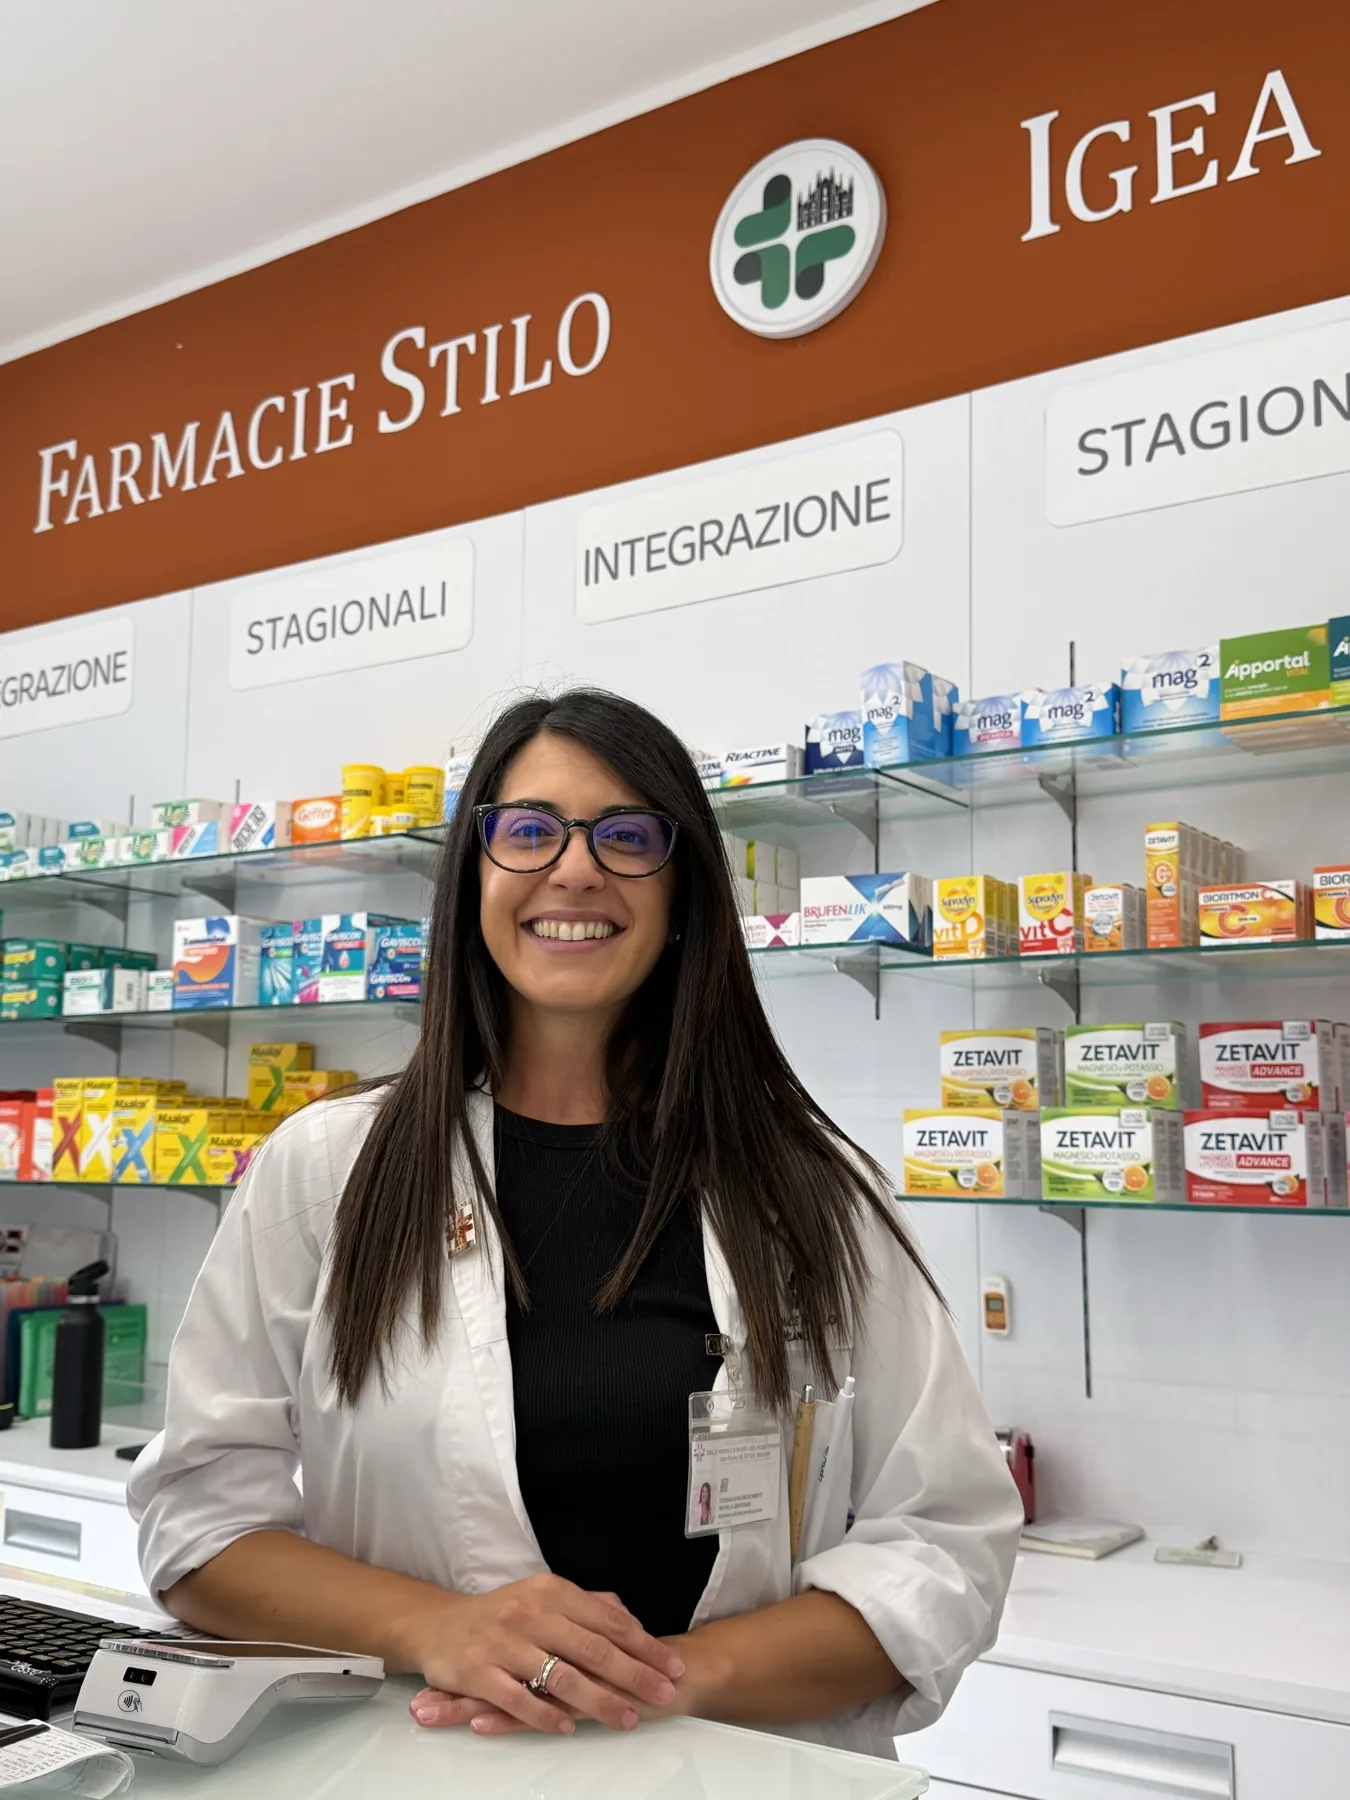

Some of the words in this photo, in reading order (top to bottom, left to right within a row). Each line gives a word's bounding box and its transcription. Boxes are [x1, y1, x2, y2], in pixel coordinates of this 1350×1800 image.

[1020, 69, 1322, 242] IGEA
[33, 375, 356, 534] FARMACIE
[377, 292, 611, 434] STILO
[1078, 372, 1350, 476] STAGION
[583, 478, 891, 586] INTEGRAZIONE
[246, 581, 447, 655] STAGIONALI
[1224, 650, 1310, 680] Apportal
[0, 650, 127, 708] GRAZIONE
[725, 747, 782, 763] REACTINE
[941, 895, 976, 908] Supradyn
[1027, 892, 1064, 905] Supradyn
[1202, 891, 1259, 903] BIORITMON
[1019, 921, 1047, 940] vit
[953, 1049, 1023, 1067] ZETAVIT
[1080, 1044, 1160, 1061] ZETAVIT
[1215, 1043, 1300, 1061] ZETAVIT
[1252, 1065, 1302, 1076] ADVANCE
[115, 1099, 149, 1111] Maalox
[158, 1112, 194, 1124] Maalox
[210, 1136, 246, 1148] Maalox
[916, 1130, 988, 1147] ZETAVIT
[1056, 1131, 1136, 1148] ZETAVIT
[1200, 1132, 1287, 1150] ZETAVIT
[1238, 1156, 1290, 1168] ADVANCE
